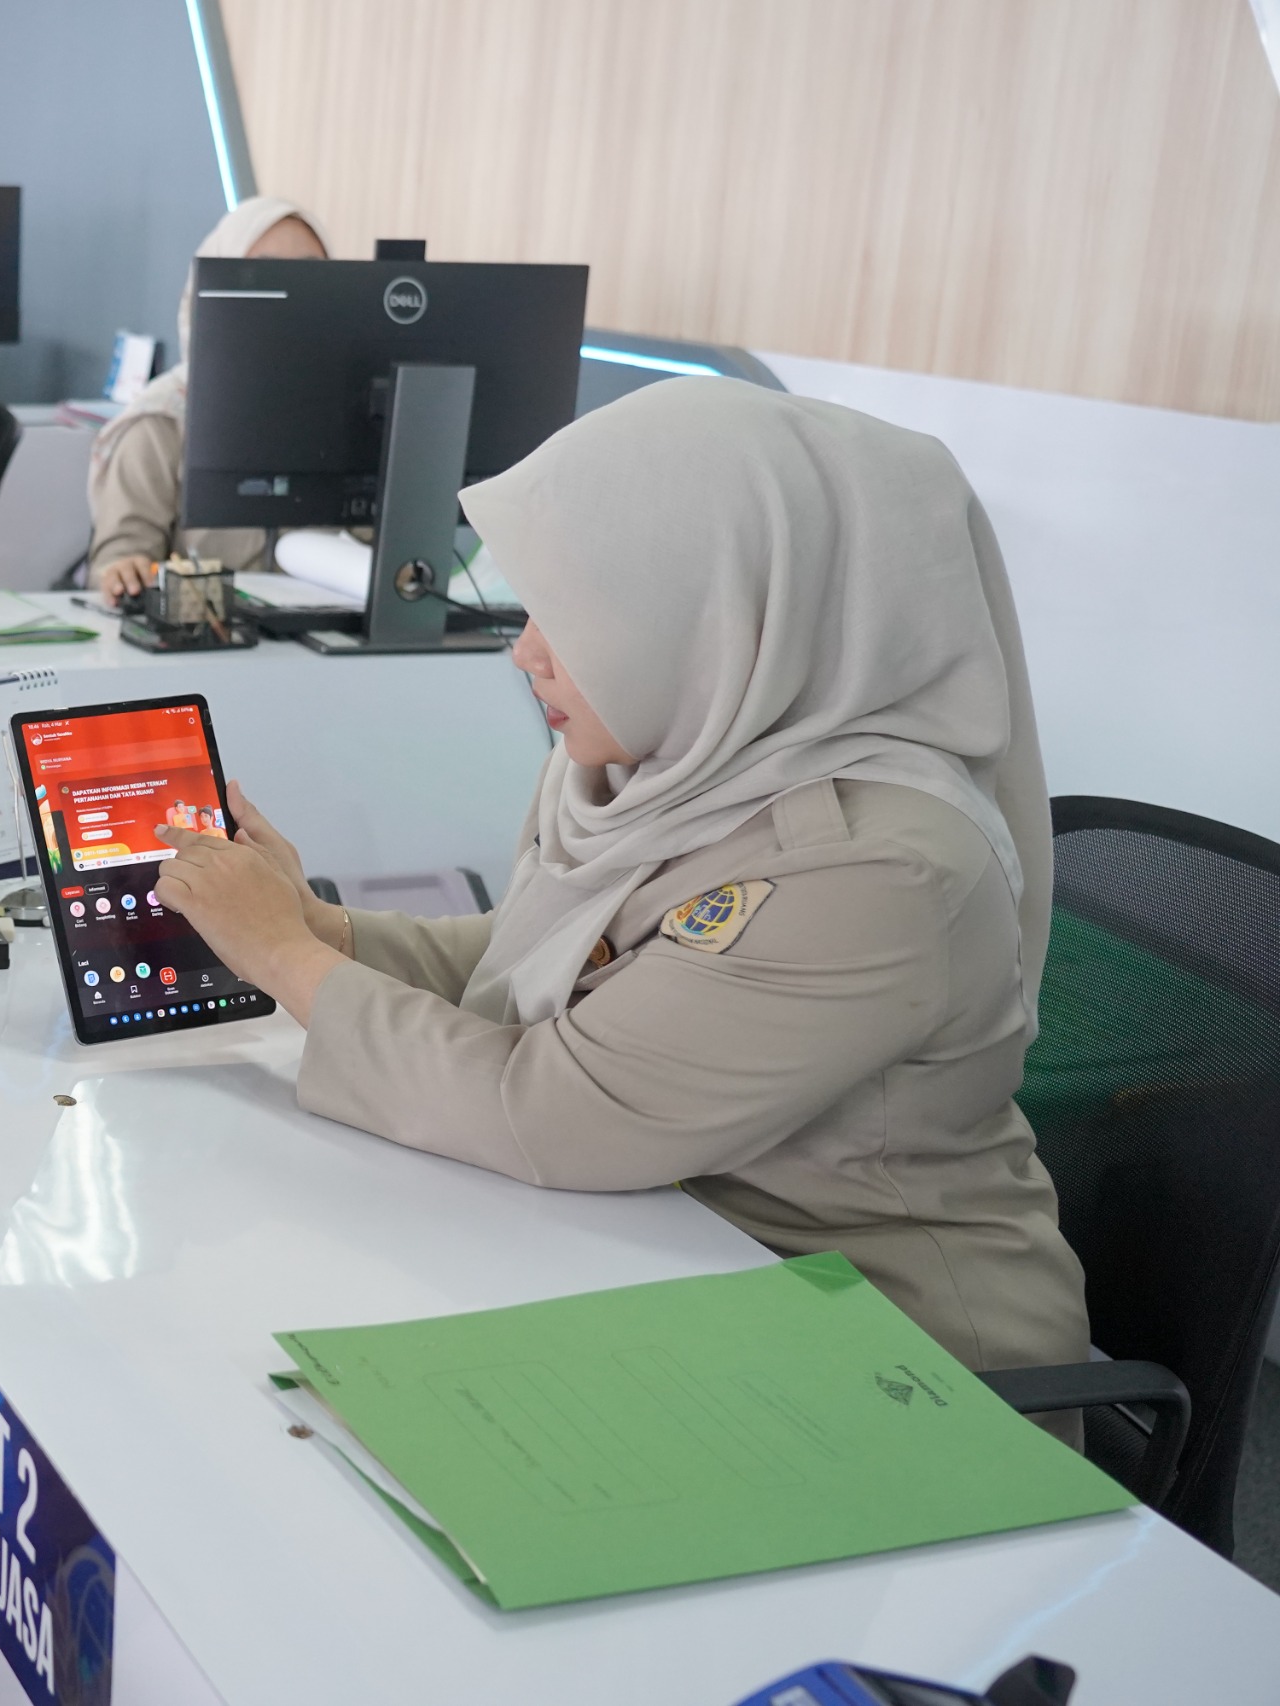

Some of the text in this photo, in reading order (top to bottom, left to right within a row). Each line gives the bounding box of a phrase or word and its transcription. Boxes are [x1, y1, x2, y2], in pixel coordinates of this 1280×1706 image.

[389, 294, 421, 308] DELL
[72, 779, 168, 797] DAPATKAN INFORMASI RESMI TERKAIT
[73, 795, 110, 804] PERTANAHAN
[121, 790, 136, 798] TATA
[136, 788, 154, 796] RUANG
[894, 1364, 949, 1407] Diamond
[16, 1447, 38, 1565] 2
